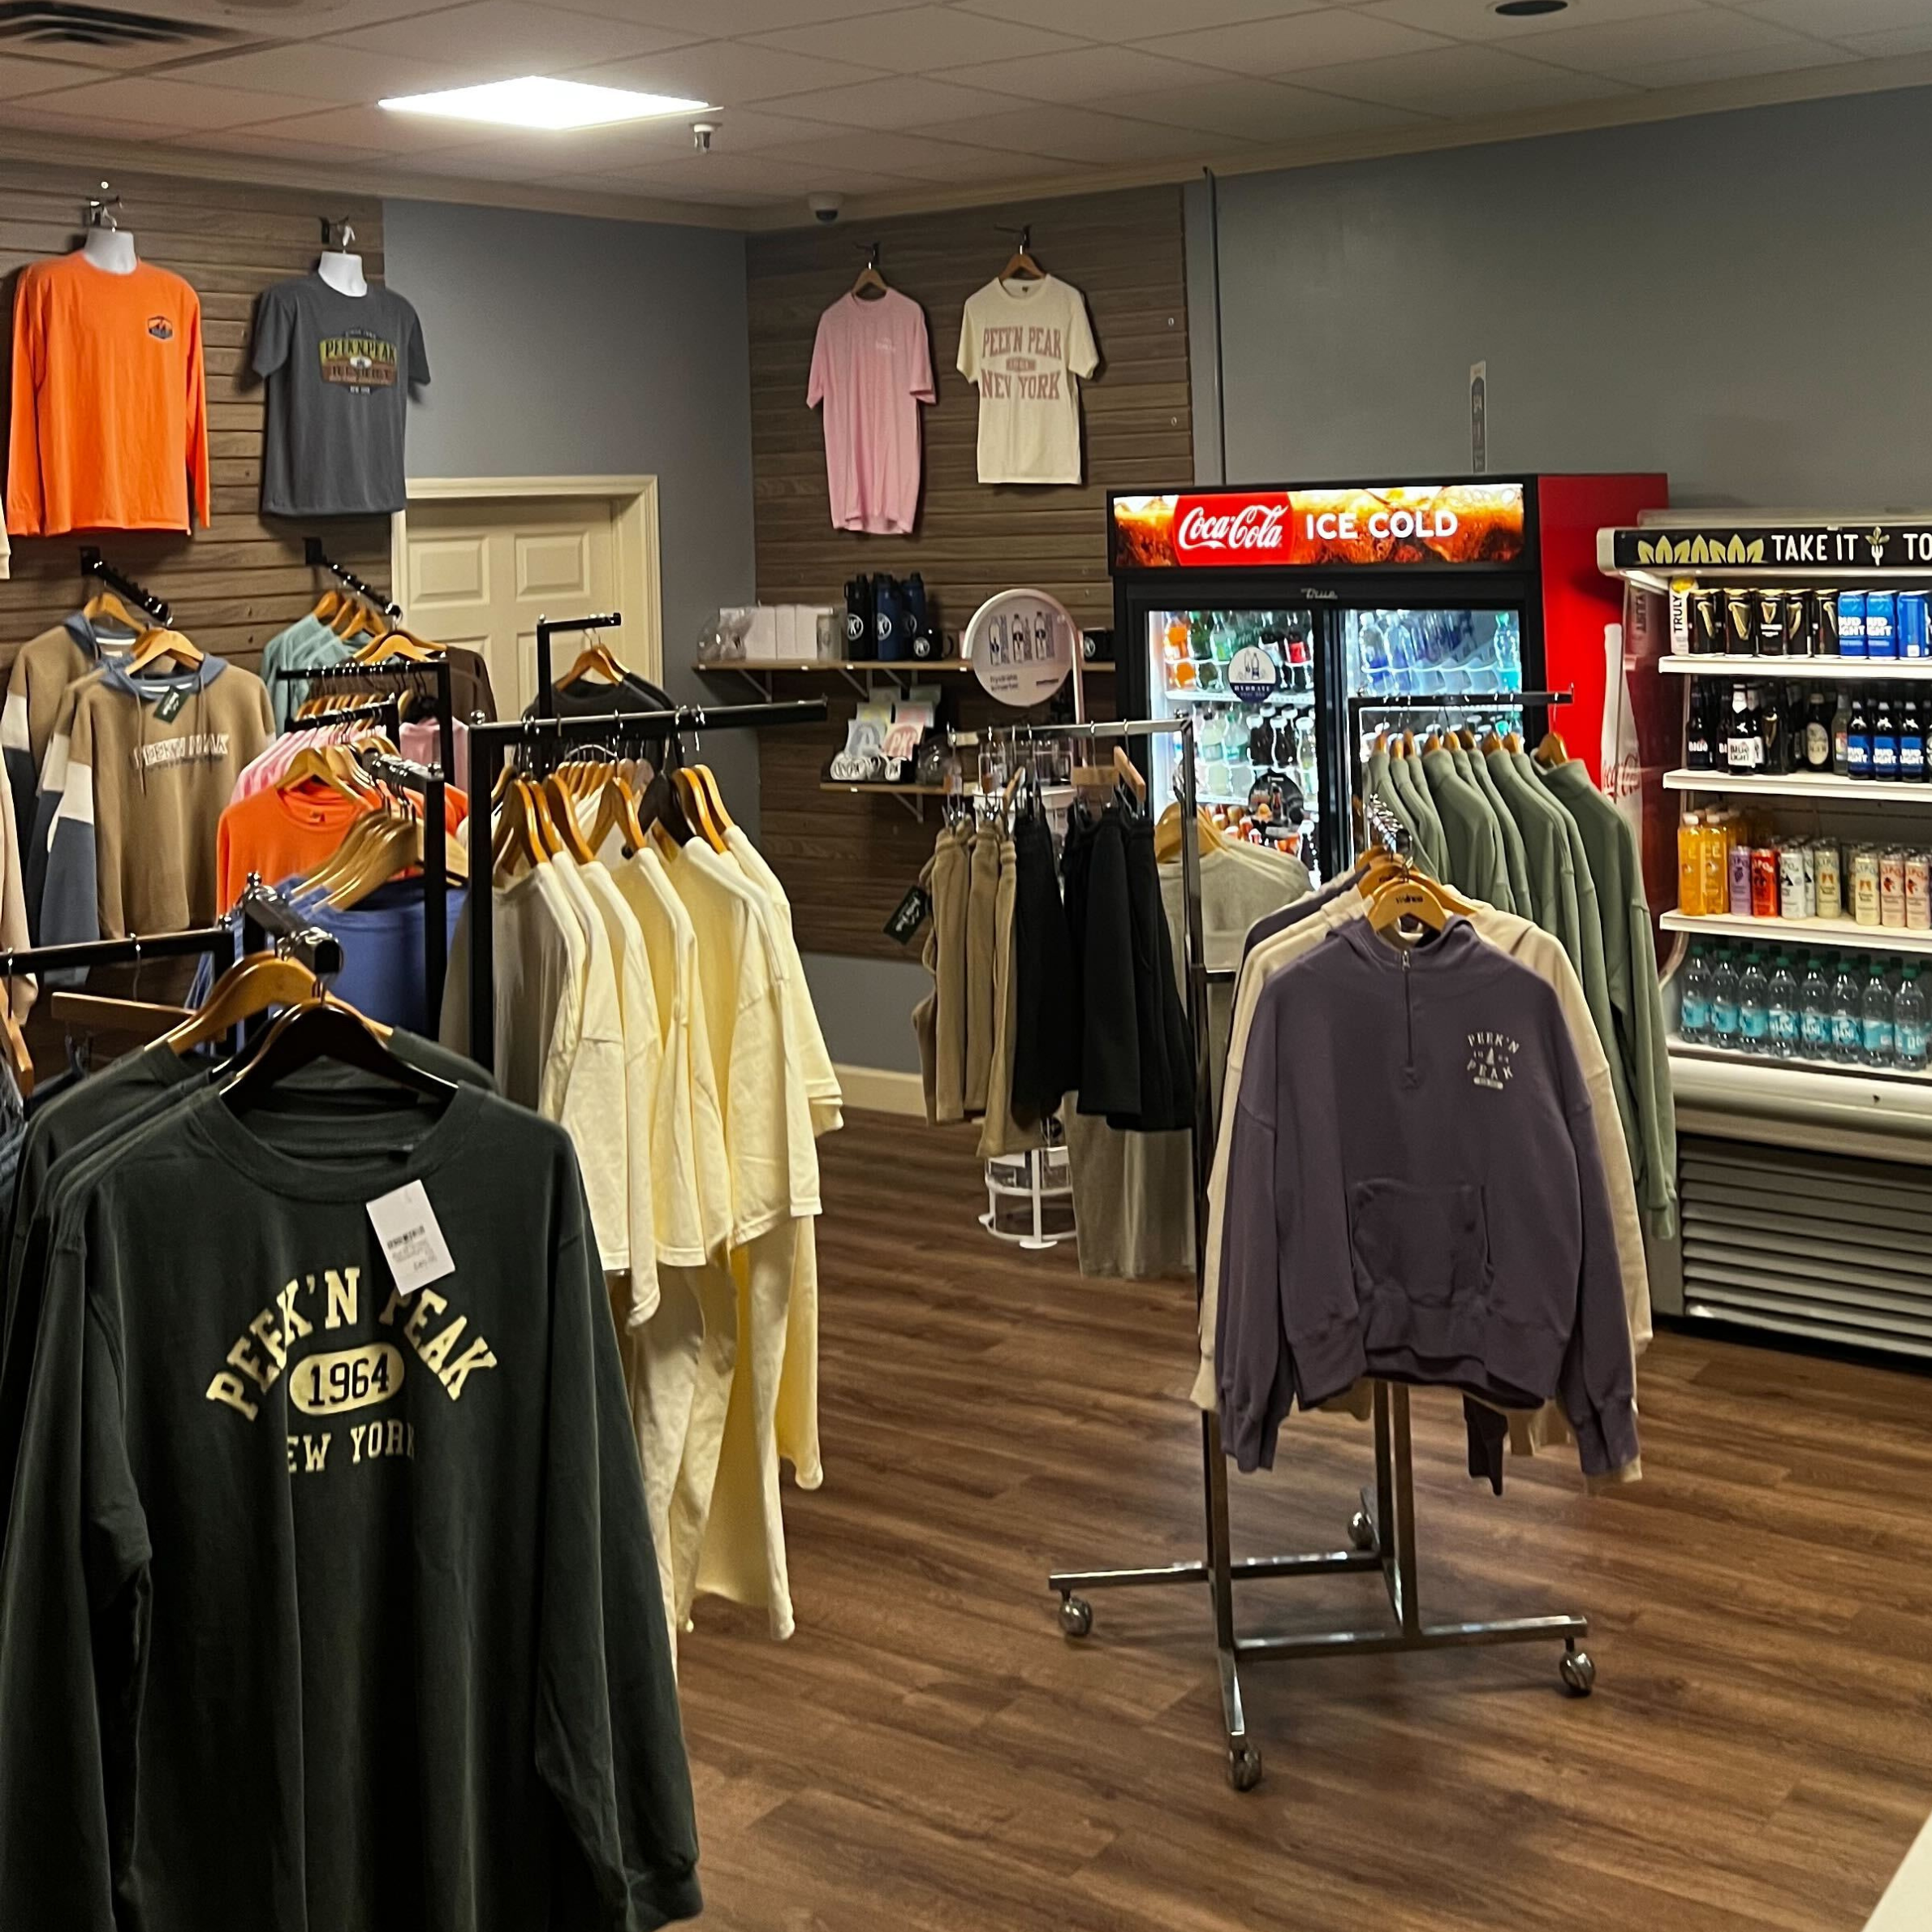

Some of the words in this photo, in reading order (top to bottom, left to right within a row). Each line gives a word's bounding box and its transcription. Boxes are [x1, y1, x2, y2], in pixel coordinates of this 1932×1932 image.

[1018, 371, 1061, 399] YORK
[1178, 504, 1289, 550] Coca-Cola
[1306, 513, 1358, 540] ICE
[1369, 509, 1459, 539] COLD
[1770, 534, 1828, 562] TAKE
[1836, 534, 1859, 561] IT
[1300, 588, 1338, 600] True
[1672, 595, 1683, 634] TRULY
[1467, 1032, 1520, 1054] PEEK'N
[206, 1267, 360, 1421] PEEK'N
[308, 1352, 390, 1406] 1964
[287, 1432, 331, 1473] EW
